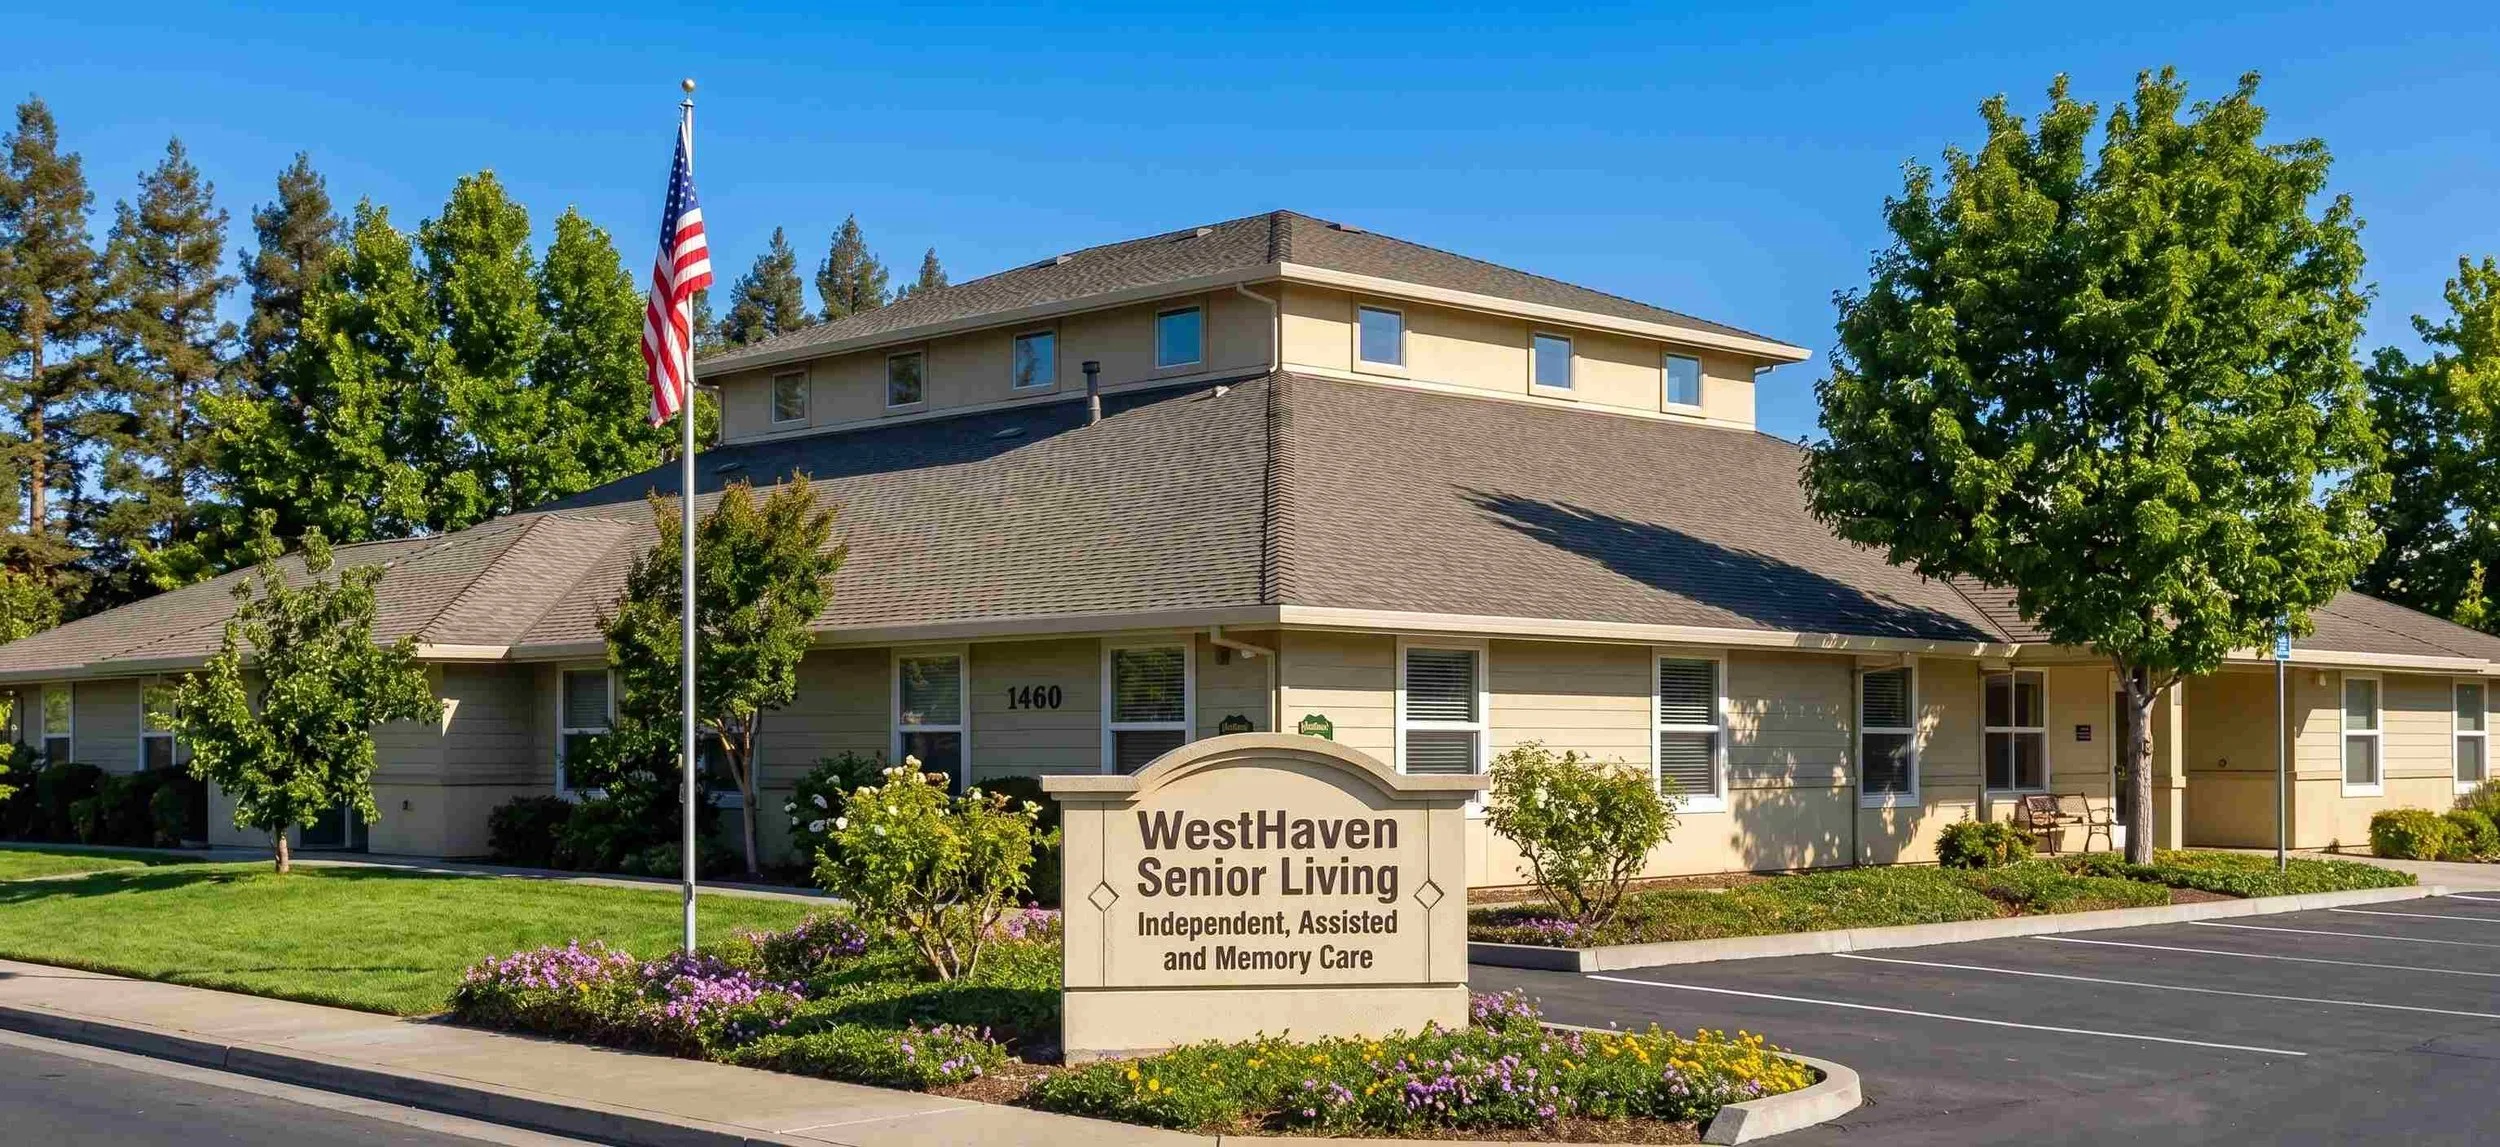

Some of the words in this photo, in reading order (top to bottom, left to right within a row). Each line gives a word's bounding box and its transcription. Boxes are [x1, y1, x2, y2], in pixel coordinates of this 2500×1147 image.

[1008, 685, 1062, 709] 1460
[1137, 810, 1398, 850] WestHaven
[1138, 857, 1266, 897] Senior
[1282, 856, 1399, 904] Living
[1138, 911, 1290, 941] Independent,
[1298, 909, 1398, 934] Assisted
[1164, 946, 1206, 970] and
[1216, 946, 1312, 975] Memory
[1320, 945, 1373, 969] Care
